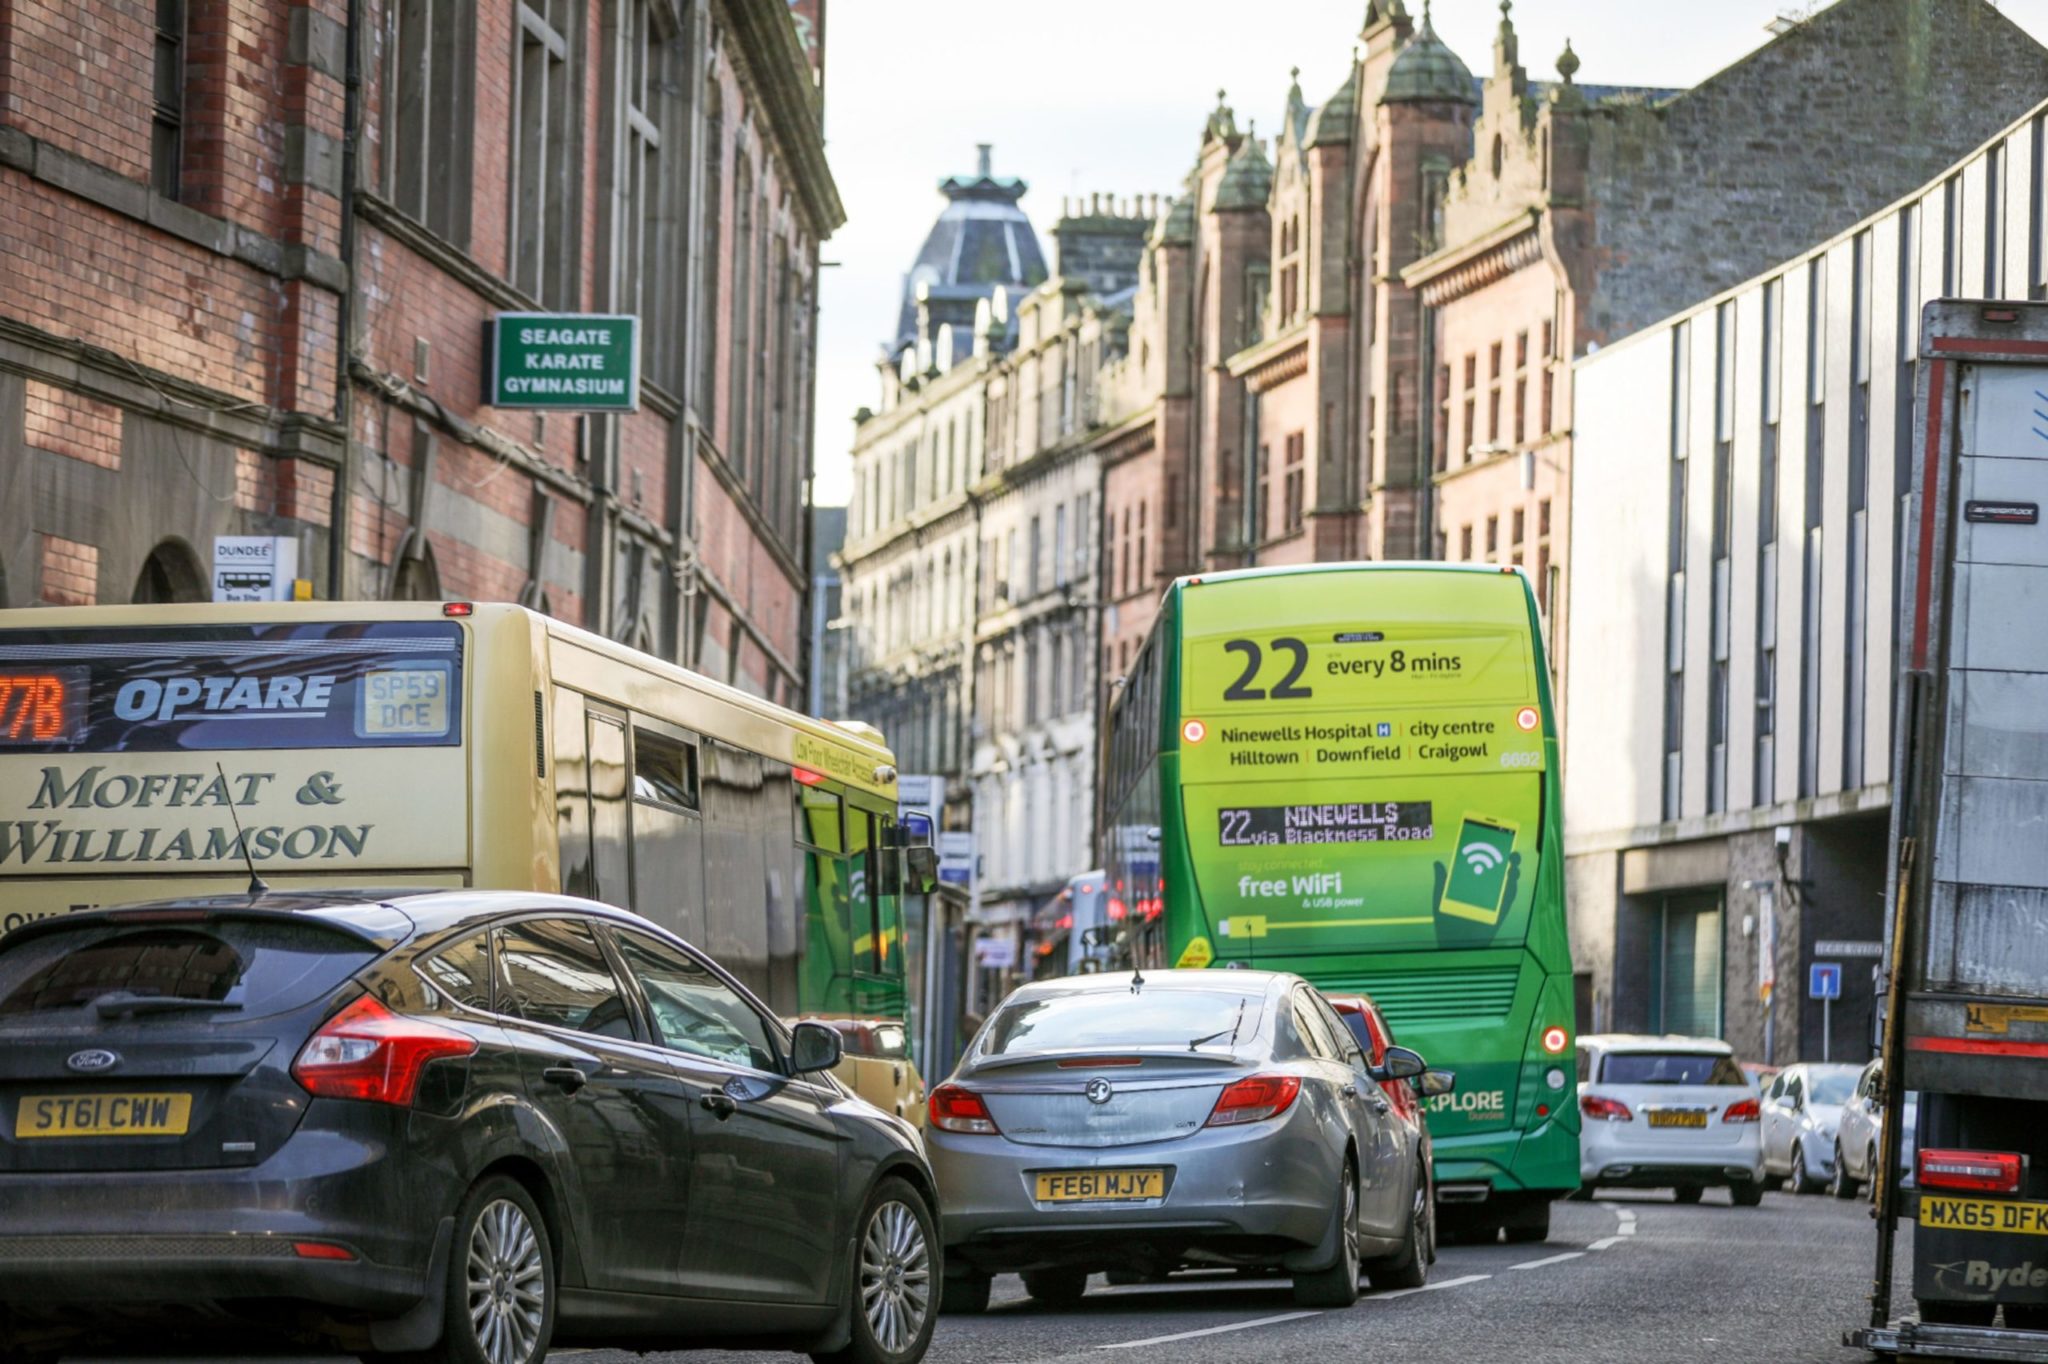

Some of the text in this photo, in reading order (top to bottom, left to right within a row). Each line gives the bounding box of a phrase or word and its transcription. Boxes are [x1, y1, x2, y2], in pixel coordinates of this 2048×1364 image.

[520, 328, 611, 345] SEAGATE
[525, 353, 604, 370] KARATE
[504, 377, 625, 395] GYMNASIUM
[218, 546, 268, 556] DUNDEE
[1223, 637, 1312, 701] 22
[1327, 650, 1461, 678] every 8 mins
[113, 675, 337, 721] OPTARE
[371, 674, 440, 700] SP59
[380, 703, 431, 728] DCE
[1221, 727, 1301, 743] Ninewells
[1305, 723, 1373, 743] Hospital
[1410, 721, 1439, 739] city
[1442, 722, 1495, 736] centre
[1230, 742, 1488, 766] Hilltown Downfield Craigowl
[1500, 751, 1540, 768] 6692
[27, 766, 346, 809] MOFFAT &
[1220, 810, 1251, 844] 22
[1284, 802, 1399, 827] NINEWELLS
[0, 820, 375, 864] WILLIAMSON
[1251, 823, 1433, 846] via Blackness Road
[1238, 871, 1342, 897] free WiFi
[1313, 897, 1333, 908] USB
[1334, 898, 1365, 909] power
[36, 1097, 171, 1129] ST61 CWW
[1049, 1174, 1150, 1196] FE61 MJY
[1930, 1201, 2048, 1230] MX65 DFK
